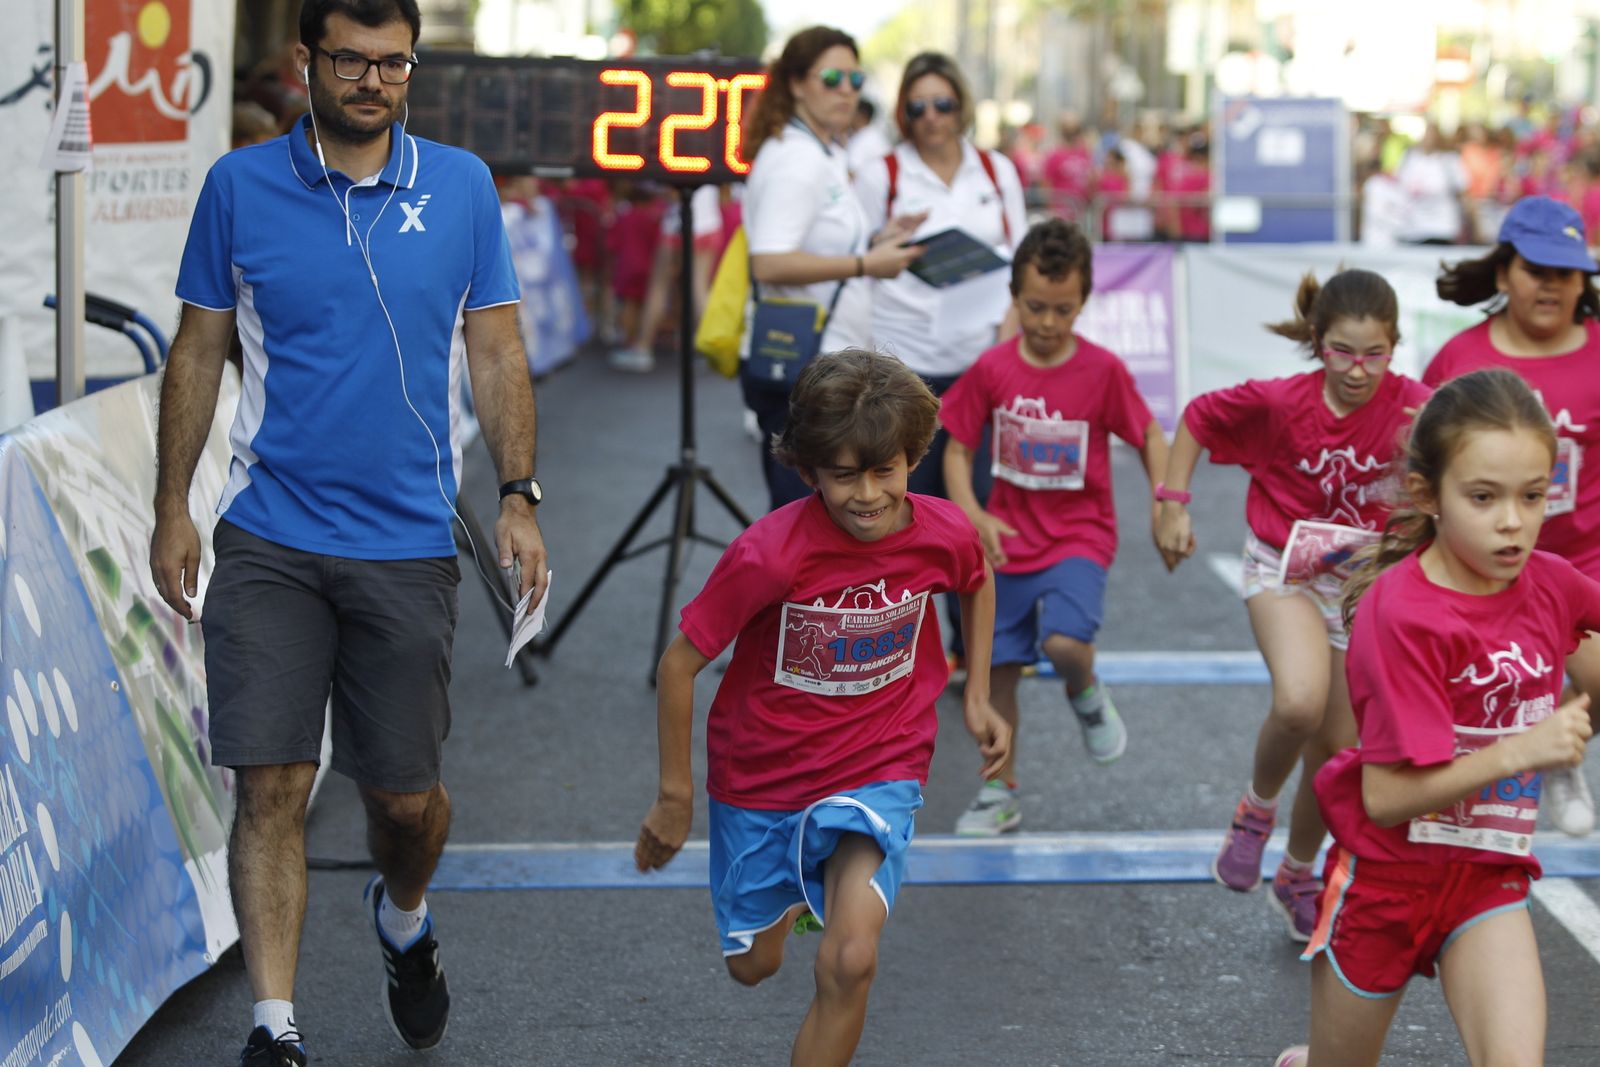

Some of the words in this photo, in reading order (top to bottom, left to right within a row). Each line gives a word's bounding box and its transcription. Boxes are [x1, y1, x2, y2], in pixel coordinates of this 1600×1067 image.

[847, 614, 885, 624] CARRERA
[885, 600, 921, 620] SOLIDARIA
[828, 622, 915, 663] 1683
[831, 663, 859, 673] JUAN
[860, 648, 905, 672] FRANCISCO
